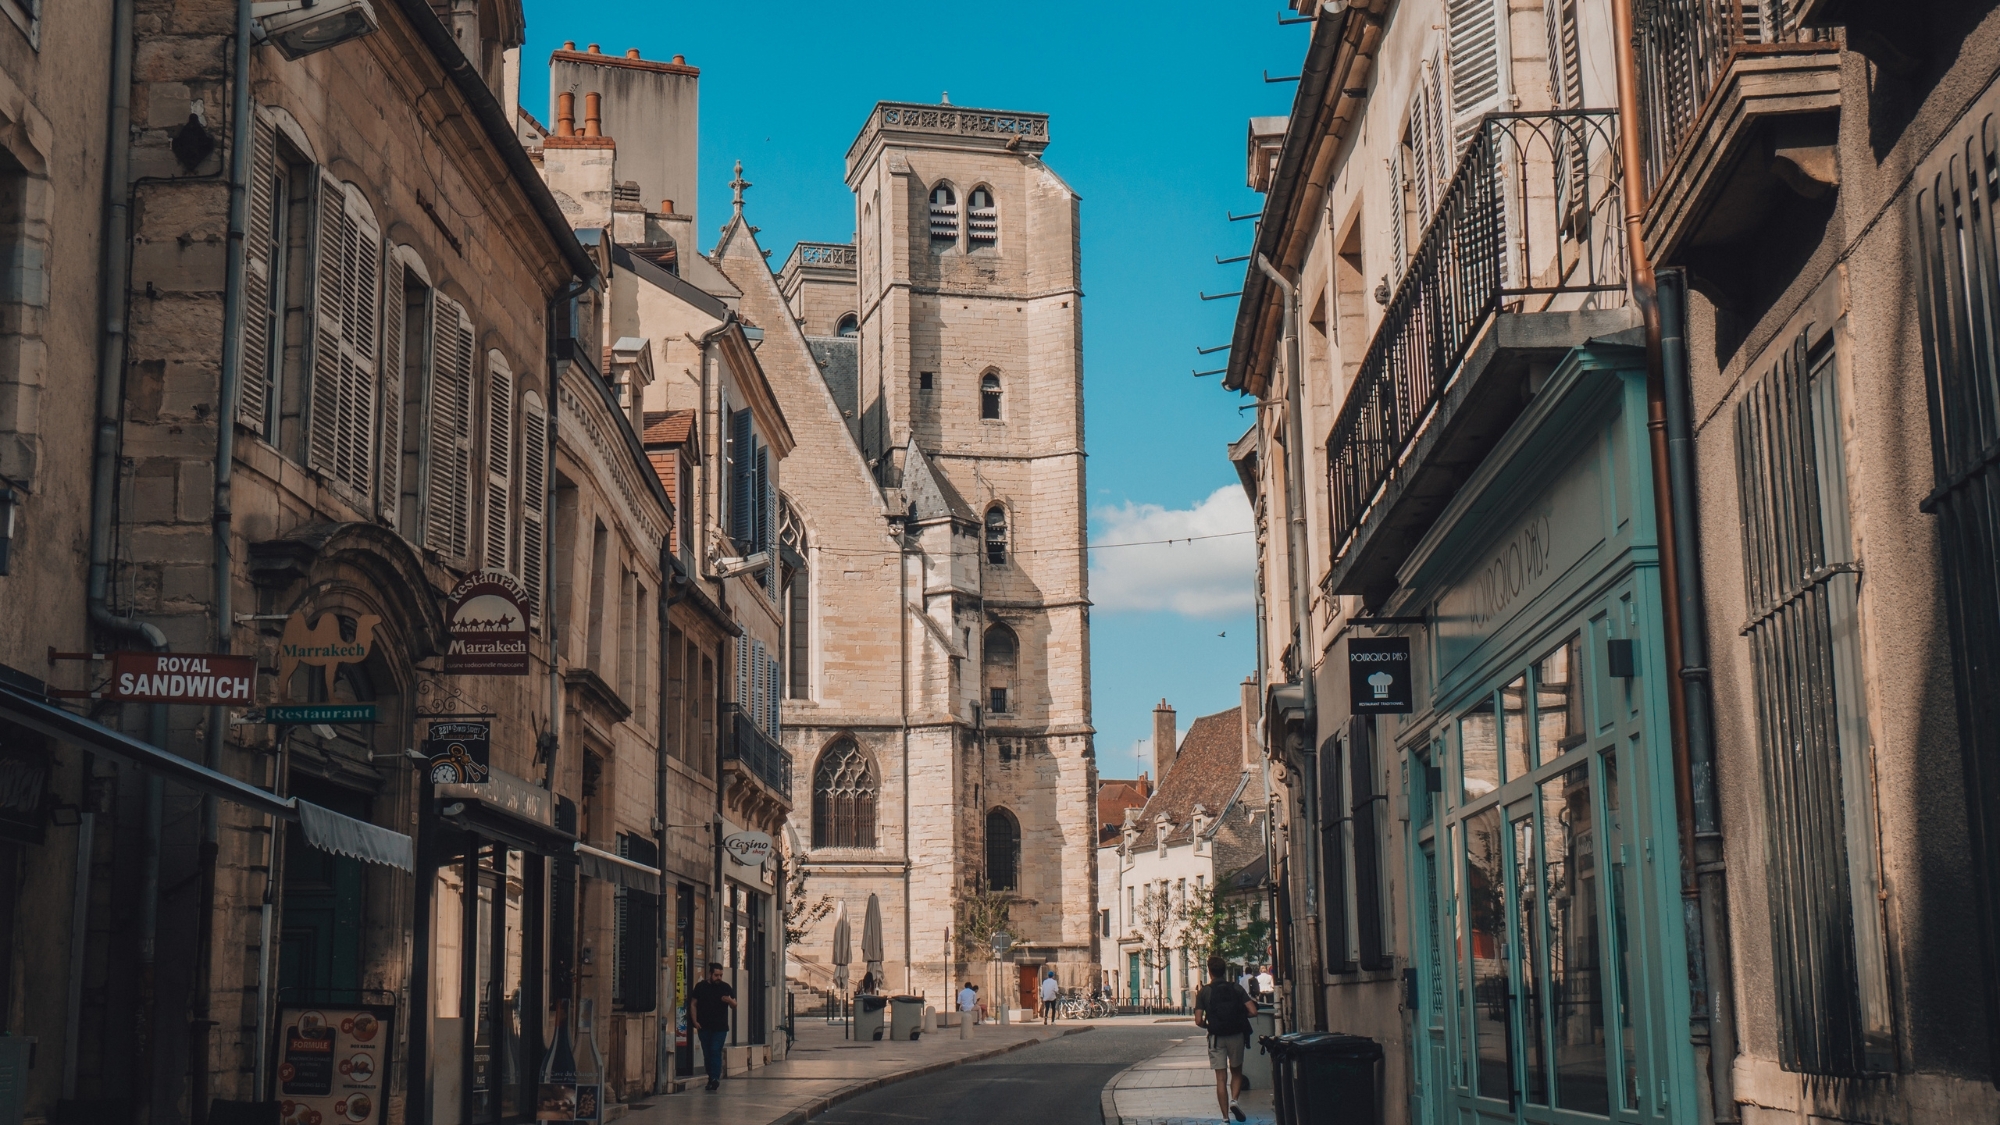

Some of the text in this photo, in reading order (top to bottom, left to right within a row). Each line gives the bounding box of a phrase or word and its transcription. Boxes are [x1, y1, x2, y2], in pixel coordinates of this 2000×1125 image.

[447, 572, 529, 605] Restaurant
[282, 643, 365, 657] Marrakech
[447, 639, 527, 655] Marrakech
[1350, 652, 1391, 662] POURQUOI
[157, 656, 211, 673] ROYAL
[118, 672, 250, 699] SANDWICH
[271, 707, 371, 720] Restaurant
[729, 838, 768, 852] Casino
[752, 848, 766, 856] shop
[293, 1041, 328, 1049] FORMULE
